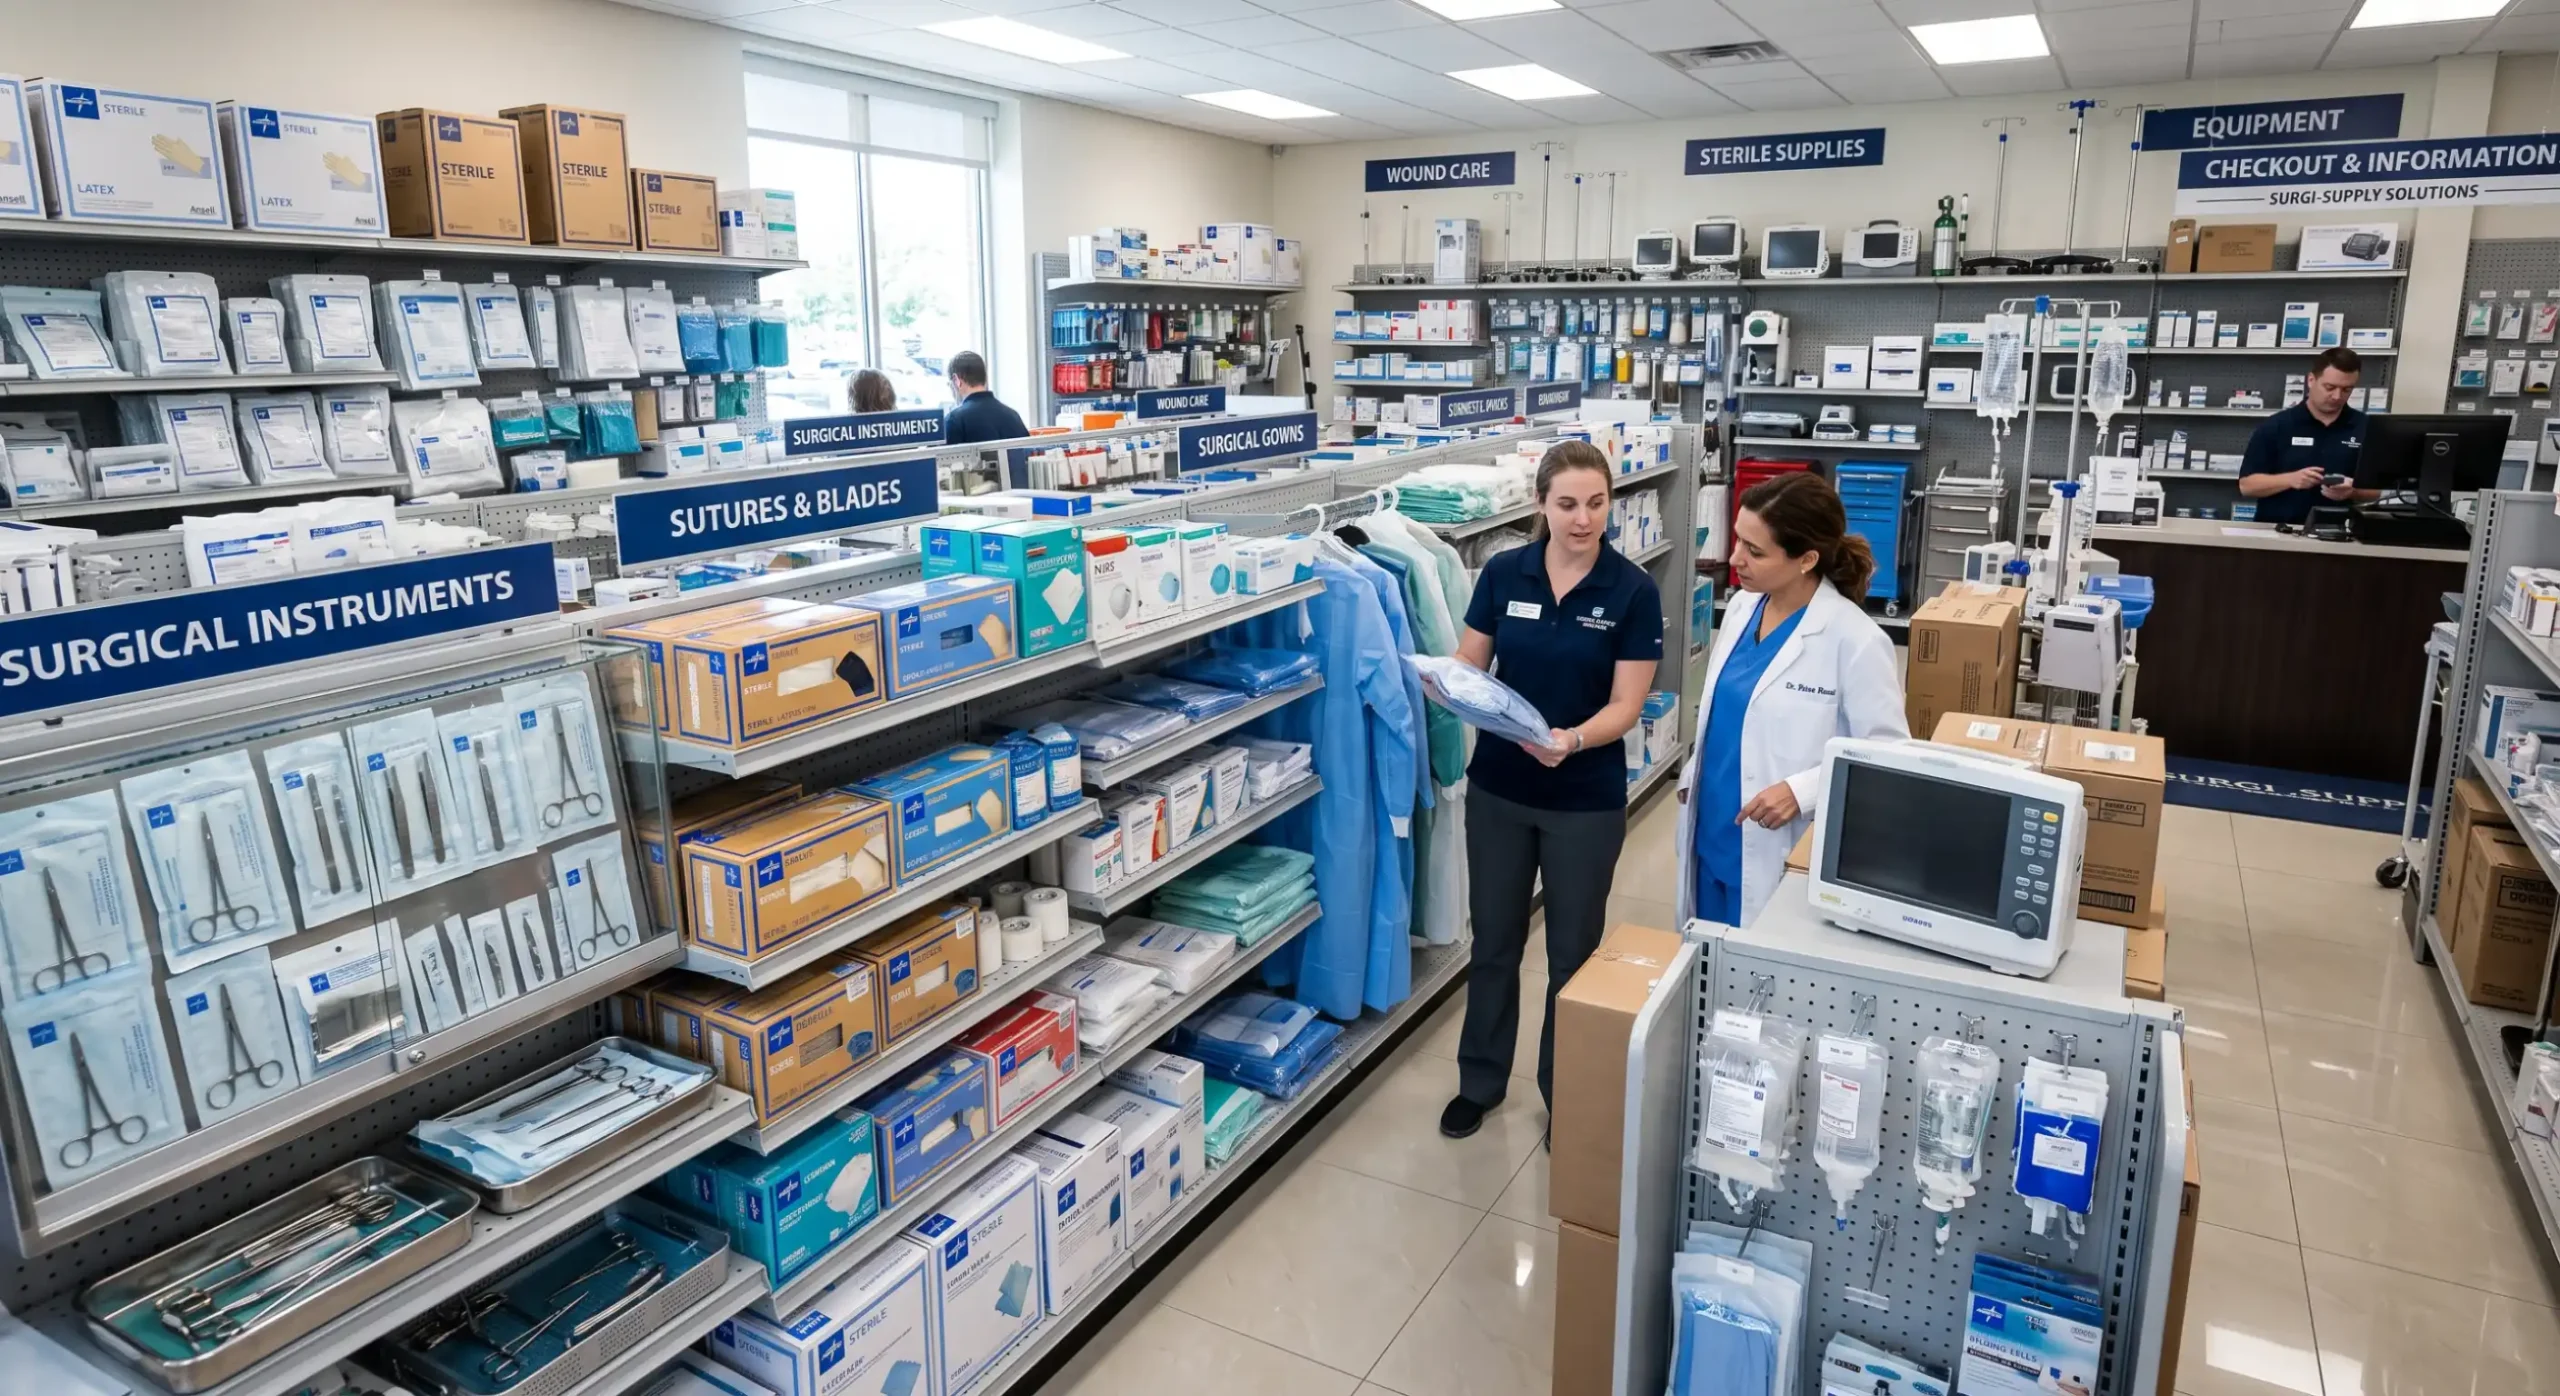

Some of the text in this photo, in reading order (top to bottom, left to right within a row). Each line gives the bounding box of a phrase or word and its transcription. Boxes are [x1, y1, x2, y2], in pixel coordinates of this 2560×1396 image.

[104, 104, 146, 116] STERILE
[283, 124, 318, 135] STERILE
[2192, 109, 2345, 139] EQUIPMENT
[1700, 139, 1865, 166] STERILE SUPPLIES
[2205, 143, 2558, 180] CHECKOUT & INFORMATION
[441, 163, 495, 180] STERILE
[563, 163, 608, 178] STERILE
[1386, 161, 1490, 183] WOUND CARE
[77, 183, 115, 195] LATEX
[2269, 184, 2480, 206] SURGI-SUPPLY SOLUTIONS
[260, 196, 293, 208] LATEX
[1156, 394, 1209, 410] WOUND CARE
[793, 418, 940, 446] SURGICAL INSTRUMENTS
[1198, 424, 1305, 457] SURGICAL GOWNS
[670, 479, 902, 538] SUTURES & BLADES
[1, 570, 515, 687] SURGICAL INSTRUMENTS
[1785, 681, 1796, 690] Dr.
